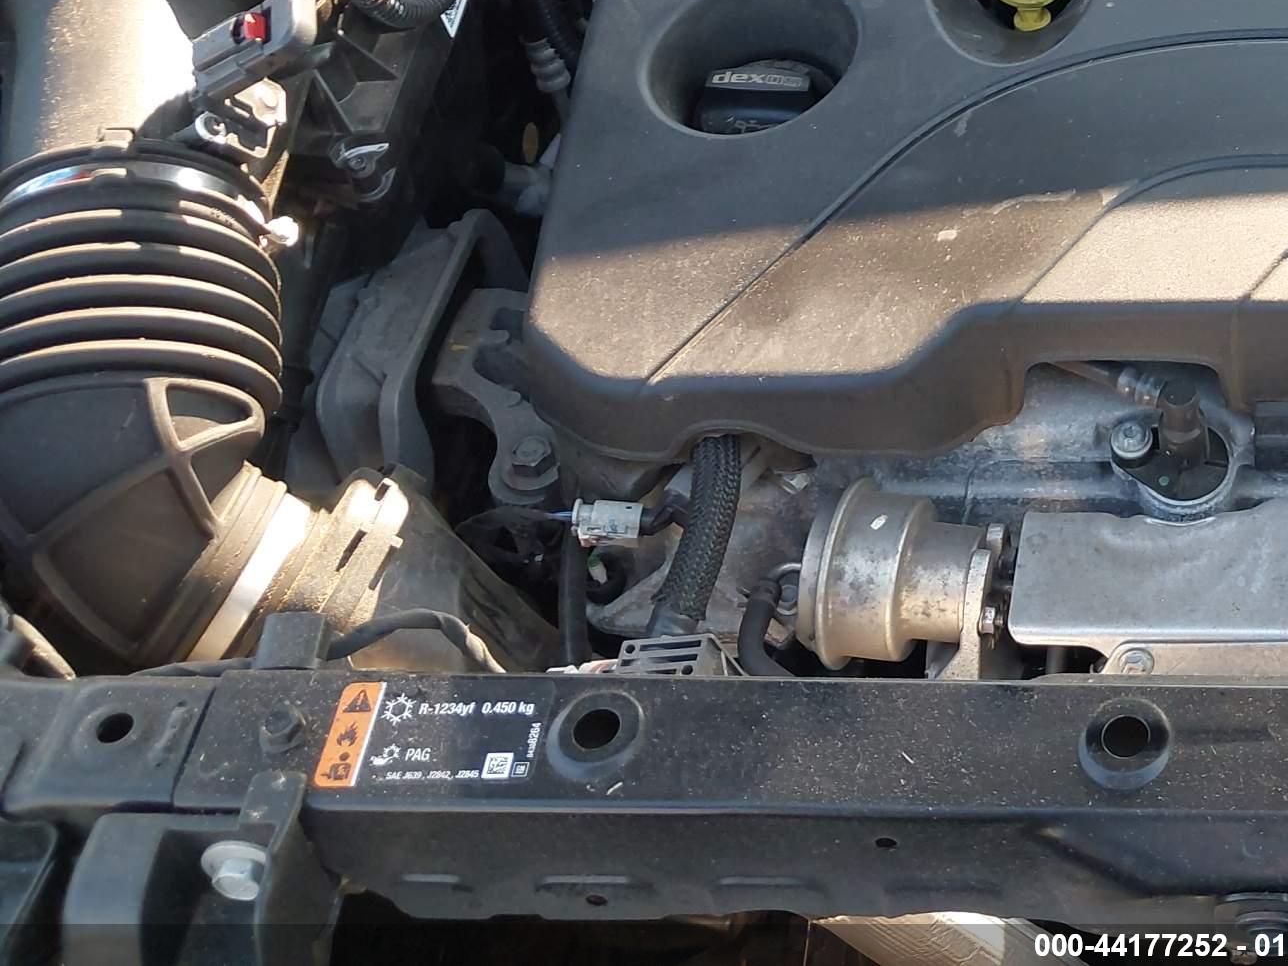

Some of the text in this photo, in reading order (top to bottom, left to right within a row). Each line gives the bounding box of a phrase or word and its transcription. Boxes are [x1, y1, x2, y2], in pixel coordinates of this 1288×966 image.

[711, 71, 803, 88] dexos
[418, 701, 535, 717] R-1234yf 0.450 kg
[405, 748, 431, 761] PAG
[385, 771, 402, 780] SAE
